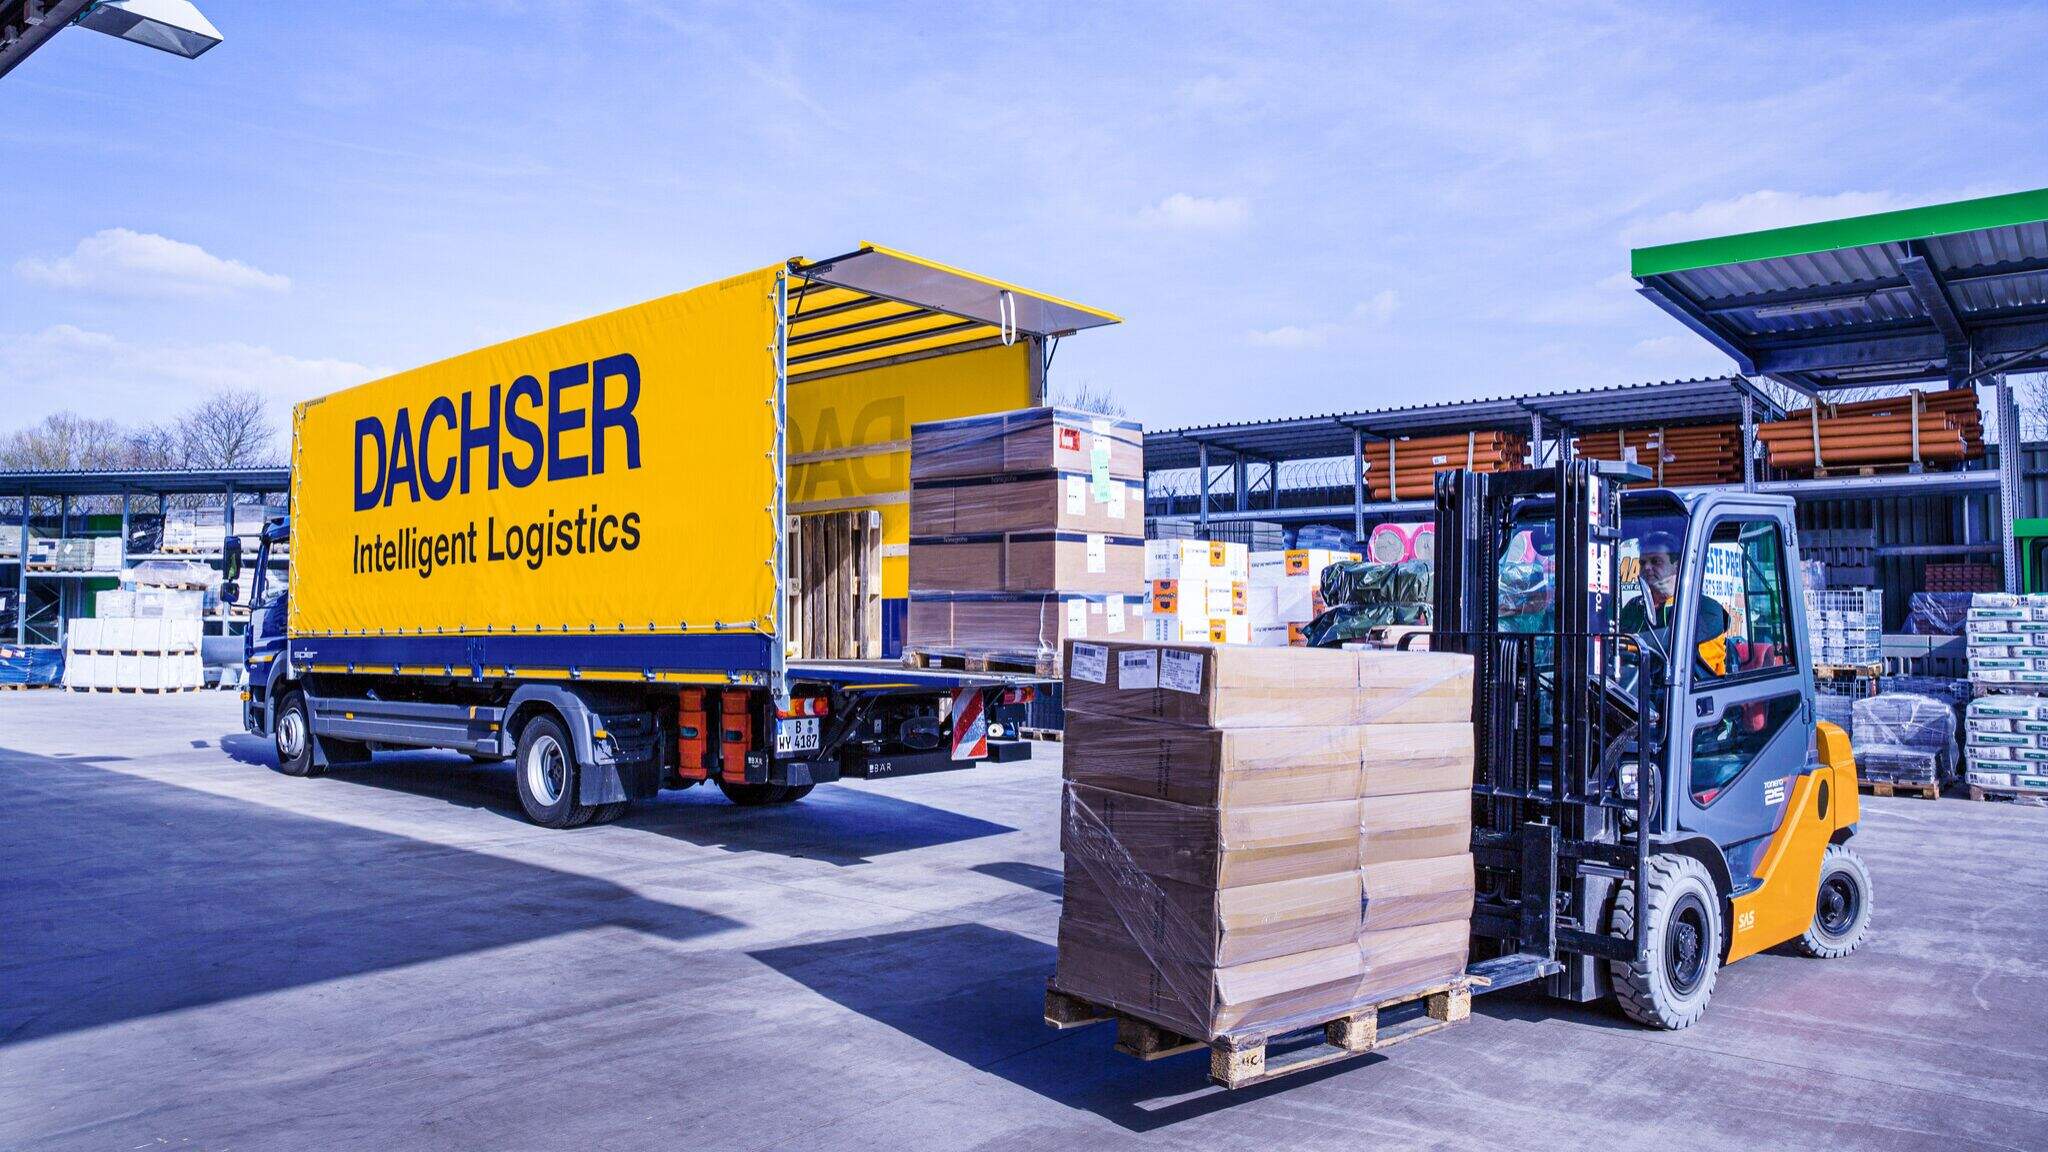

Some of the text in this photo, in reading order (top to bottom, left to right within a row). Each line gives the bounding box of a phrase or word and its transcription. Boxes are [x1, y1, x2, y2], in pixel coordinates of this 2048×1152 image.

[354, 352, 642, 512] DACHSER
[353, 504, 641, 579] Intelligent Logistics
[1706, 547, 1723, 575] ESTE
[796, 720, 802, 734] B
[795, 733, 818, 749] 4187
[874, 762, 892, 773] BAR
[1764, 786, 1785, 806] 25
[1739, 911, 1755, 927] SAS
